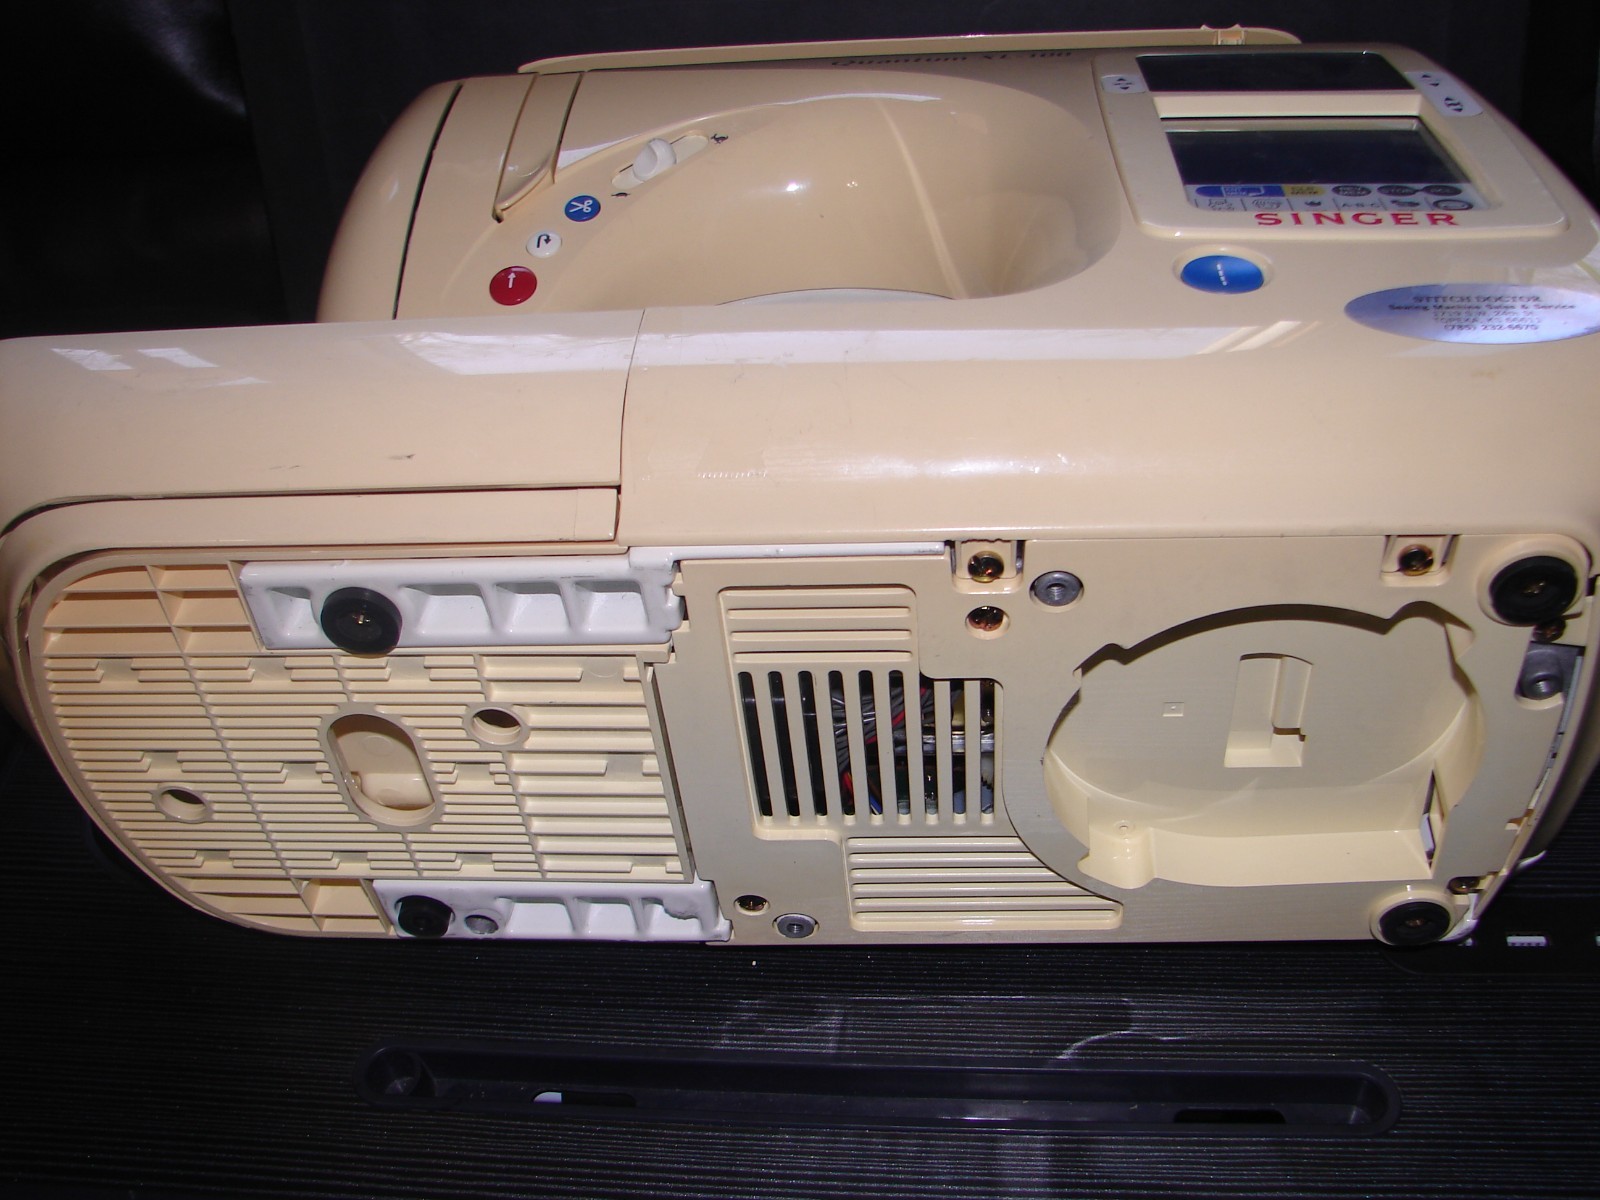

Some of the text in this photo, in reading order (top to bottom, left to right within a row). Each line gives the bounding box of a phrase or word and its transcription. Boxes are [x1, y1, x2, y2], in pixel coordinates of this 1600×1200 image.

[1254, 212, 1459, 226] SINGER
[1413, 295, 1541, 303] STITCH DOCTOR
